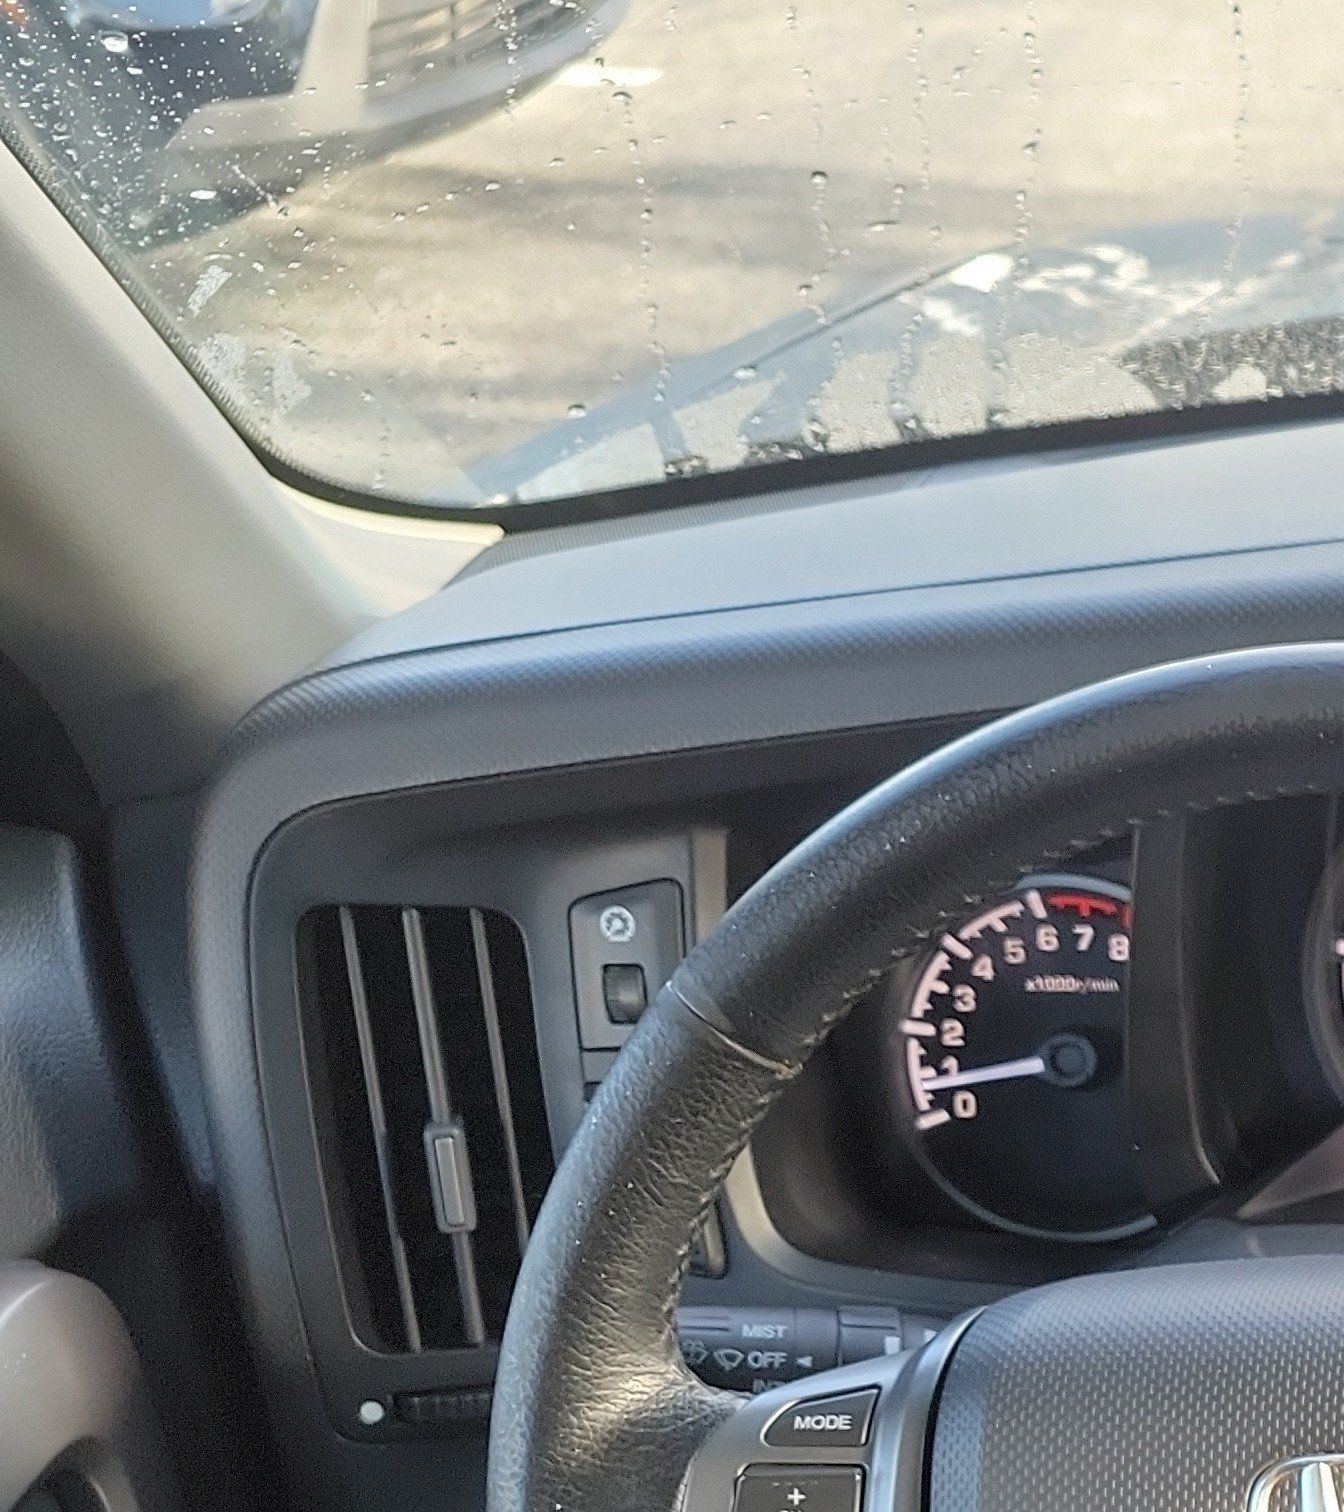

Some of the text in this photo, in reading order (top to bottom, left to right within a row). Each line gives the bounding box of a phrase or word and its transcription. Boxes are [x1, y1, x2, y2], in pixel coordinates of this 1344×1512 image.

[1004, 937, 1026, 965] 5
[1036, 924, 1059, 951] 6
[1073, 924, 1095, 952] 7
[1108, 935, 1131, 963] 8
[972, 954, 995, 981] 4
[953, 986, 977, 1013] 3
[940, 1018, 965, 1048] 2
[953, 1091, 978, 1119] 0
[741, 1323, 788, 1338] MIST
[747, 1351, 788, 1369] OFF
[793, 1415, 852, 1431] MODE
